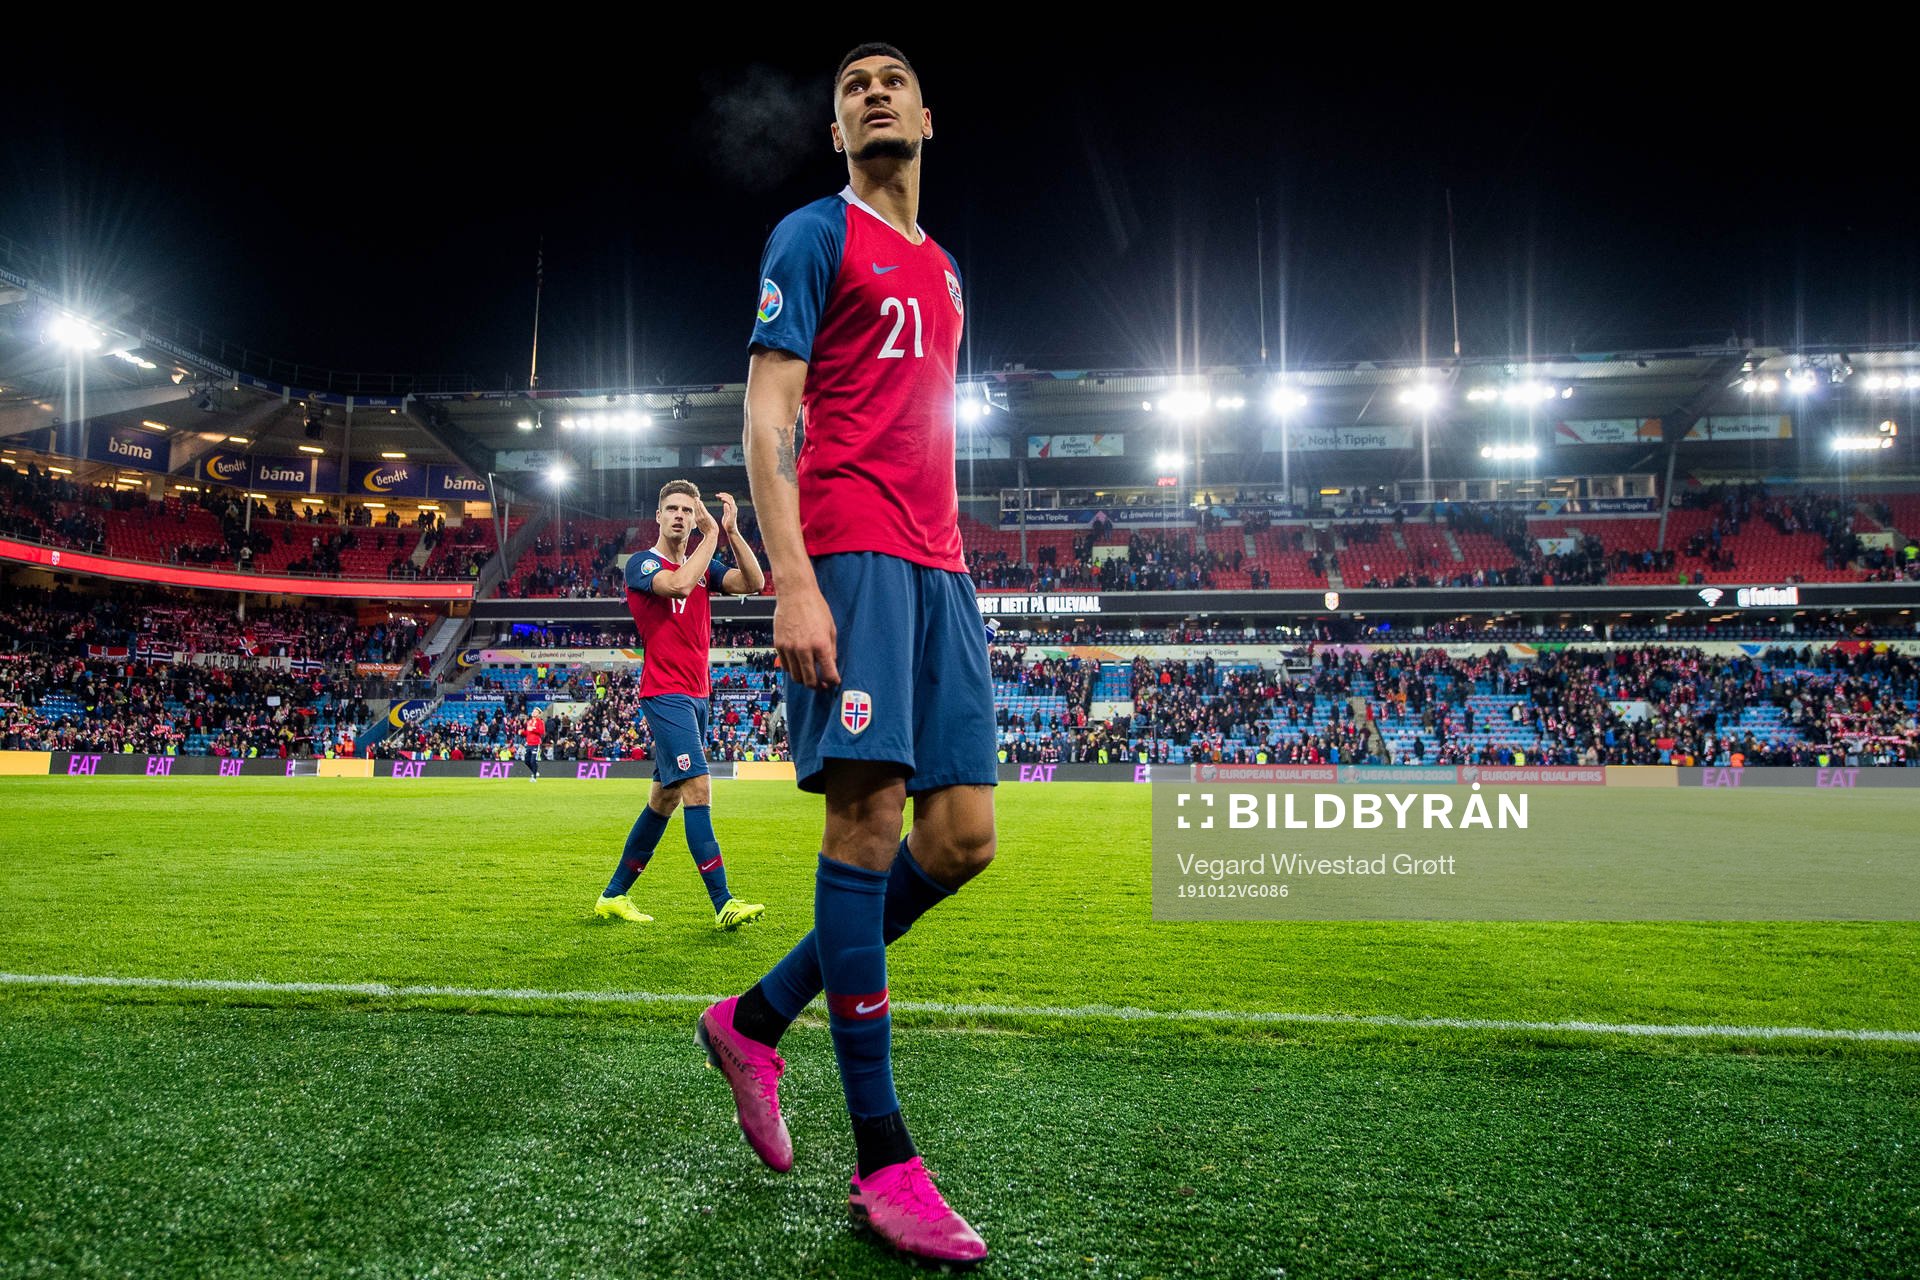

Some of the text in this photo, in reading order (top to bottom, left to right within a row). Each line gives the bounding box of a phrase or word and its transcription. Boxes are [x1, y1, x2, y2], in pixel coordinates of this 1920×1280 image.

[877, 297, 924, 359] 21
[108, 437, 152, 460] bama
[1308, 433, 1386, 447] Norsk Tipping
[217, 459, 246, 473] Bendit
[260, 466, 305, 482] bama
[376, 469, 409, 486] Bendit
[443, 476, 486, 491] bama
[1045, 513, 1069, 522] Tipping
[1000, 597, 1029, 613] NETT
[1030, 595, 1045, 613] PÅ
[1046, 596, 1101, 612] ULLEVAAL
[220, 655, 234, 669] FOR
[487, 694, 505, 702] Tipping
[68, 755, 101, 776] EAT
[146, 757, 175, 776] EAT
[219, 759, 244, 776] EAT
[392, 761, 426, 778] EAT
[479, 761, 514, 778] EAT
[576, 762, 612, 779] EAT
[1019, 765, 1057, 782] EAT
[1219, 769, 1334, 780] EUROPEAN QUALIFIERS
[1481, 771, 1602, 781] EUROPEAN QUALIFIERS
[1702, 768, 1745, 788] EAT
[1816, 768, 1860, 788] EAT
